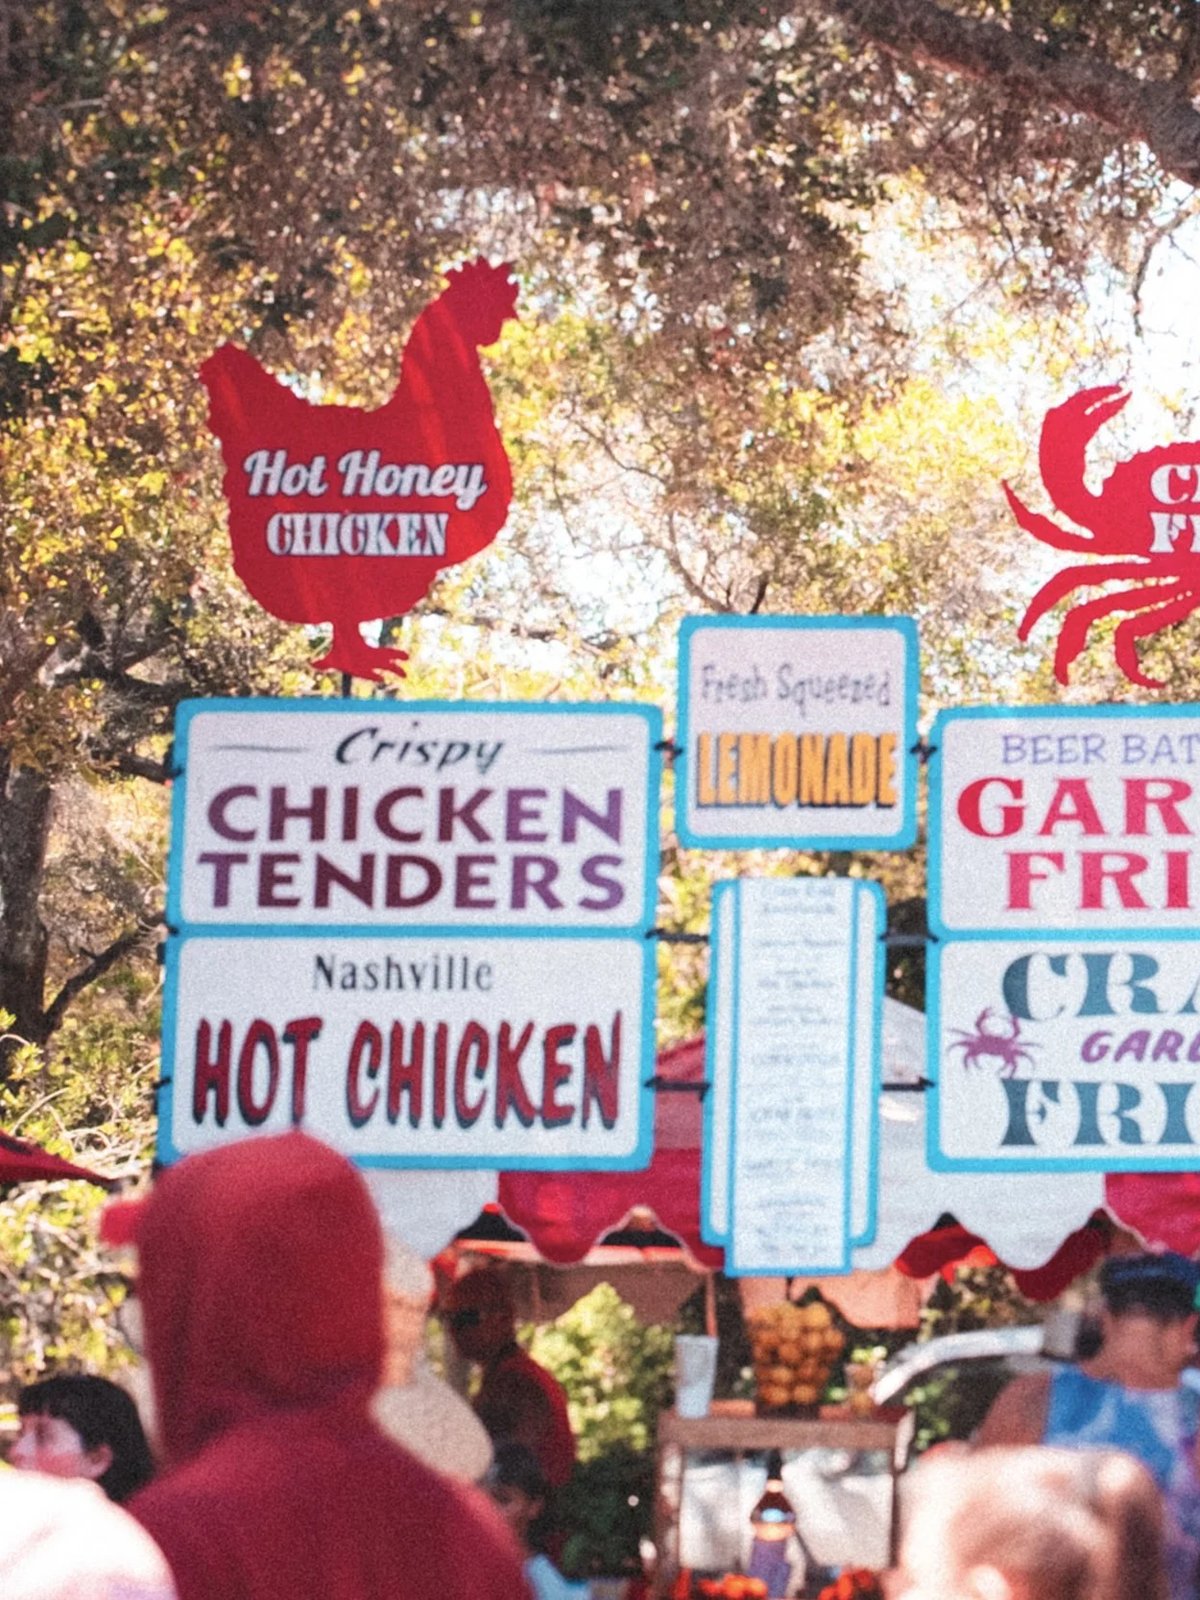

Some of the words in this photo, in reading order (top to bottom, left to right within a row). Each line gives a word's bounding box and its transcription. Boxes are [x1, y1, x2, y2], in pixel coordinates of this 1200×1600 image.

[244, 449, 328, 496] Hot
[338, 449, 487, 510] Honey
[266, 512, 449, 556] CHICKEN
[702, 663, 767, 702] Fresh
[777, 663, 890, 719] Squeezed
[336, 720, 504, 773] Crispy
[696, 731, 897, 809] LEMONADE
[1001, 733, 1107, 764] BEER
[206, 785, 623, 845] CHICKEN
[197, 852, 625, 911] TENDERS
[313, 954, 493, 991] Nashville
[193, 1016, 322, 1130] HOT
[347, 1011, 622, 1131] CHICKEN
